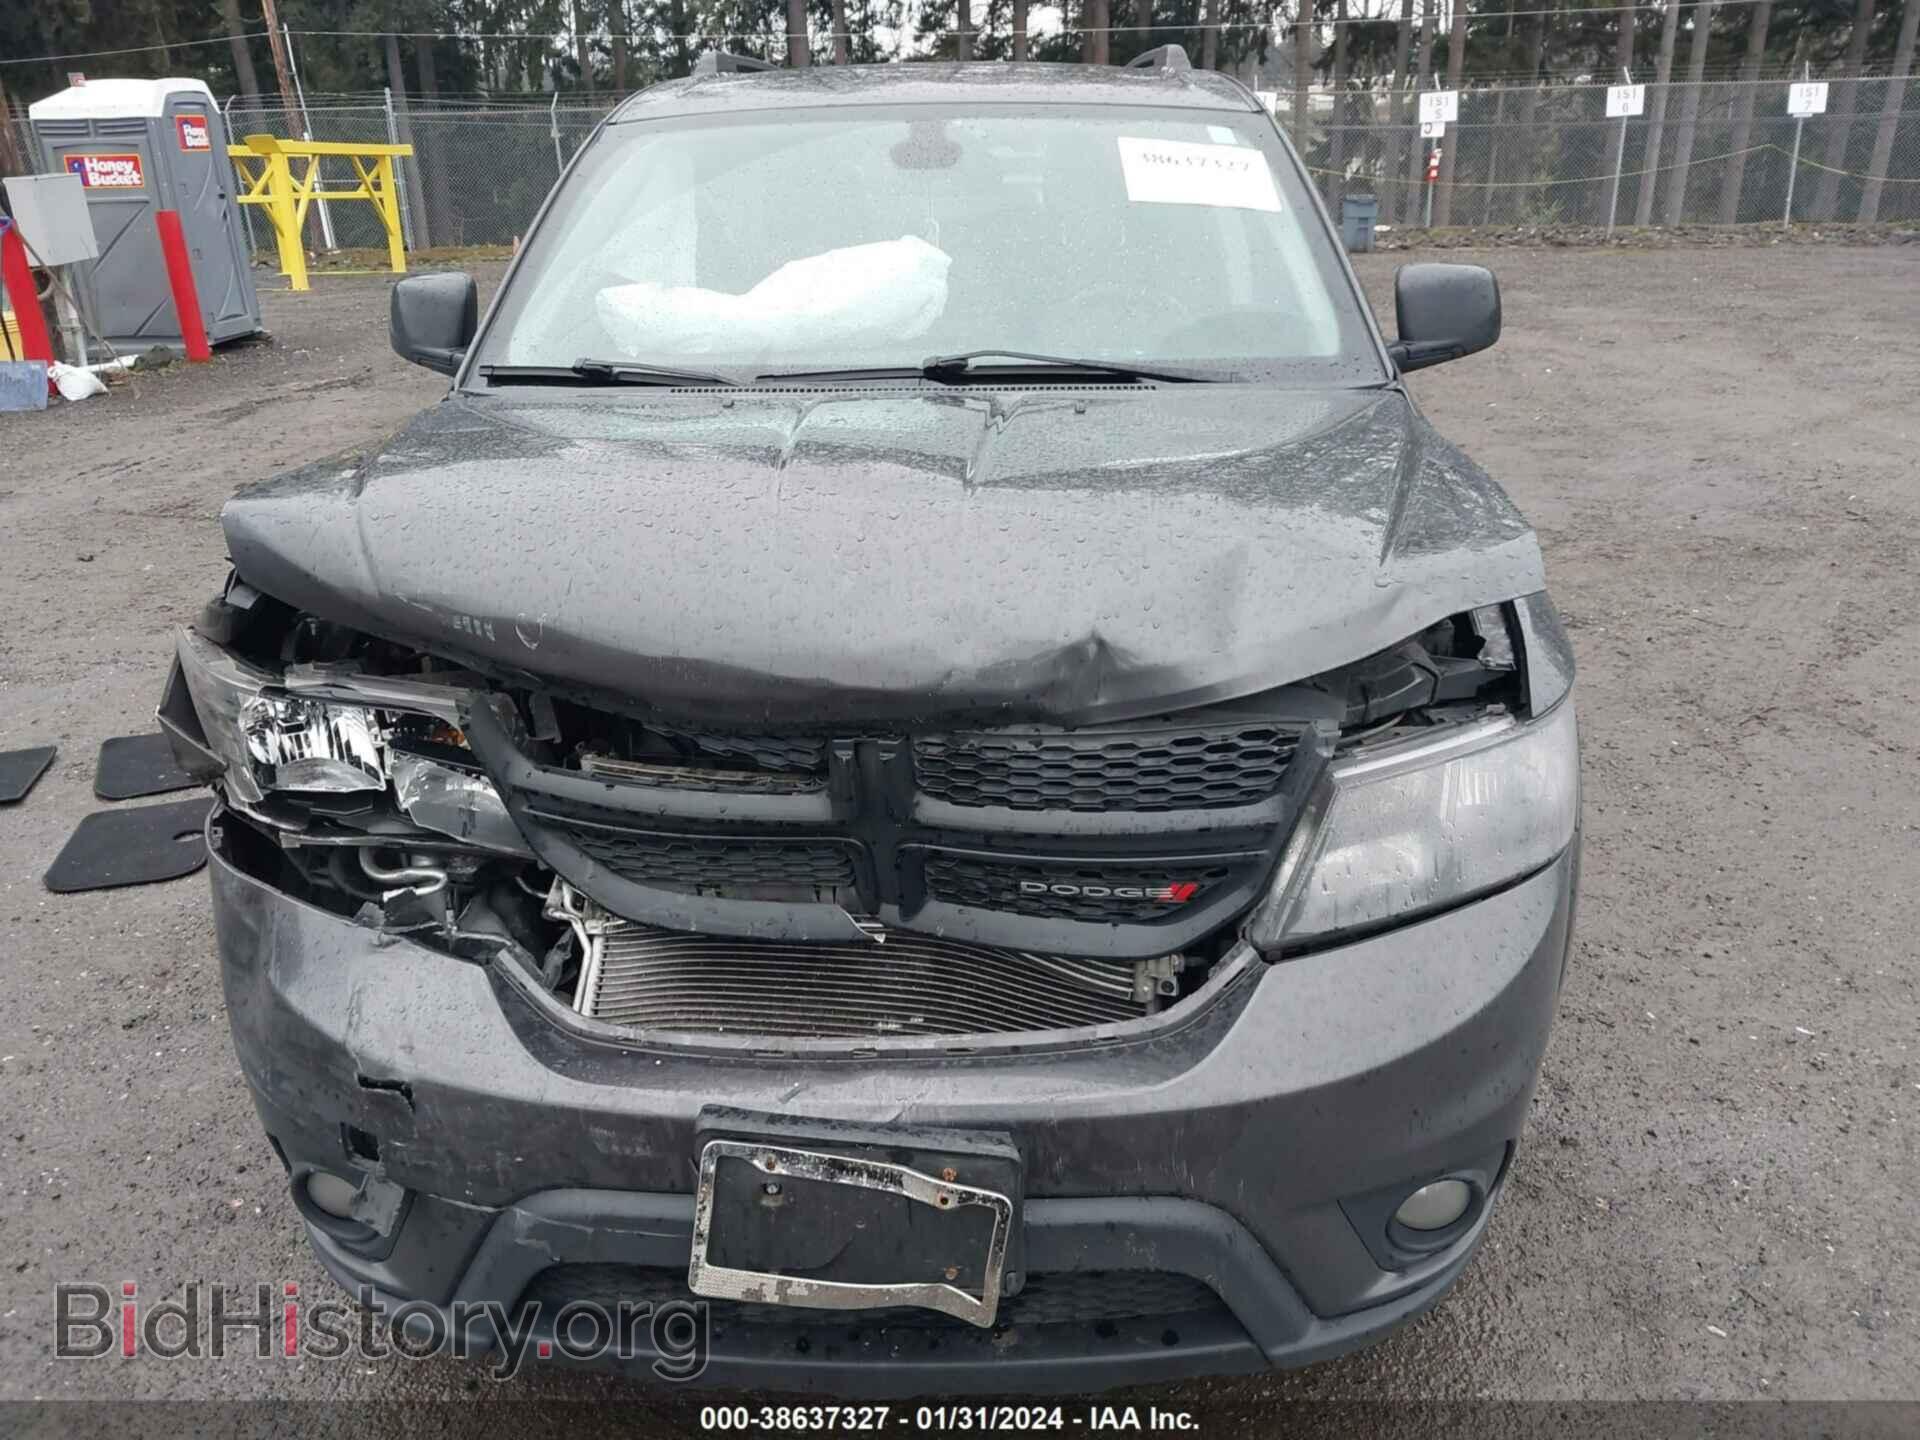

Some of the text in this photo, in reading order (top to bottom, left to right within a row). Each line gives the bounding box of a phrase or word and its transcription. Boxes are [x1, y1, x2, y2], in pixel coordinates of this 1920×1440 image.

[84, 157, 134, 173] Honey
[88, 171, 141, 186] Bucket
[1020, 881, 1174, 898] DODGE
